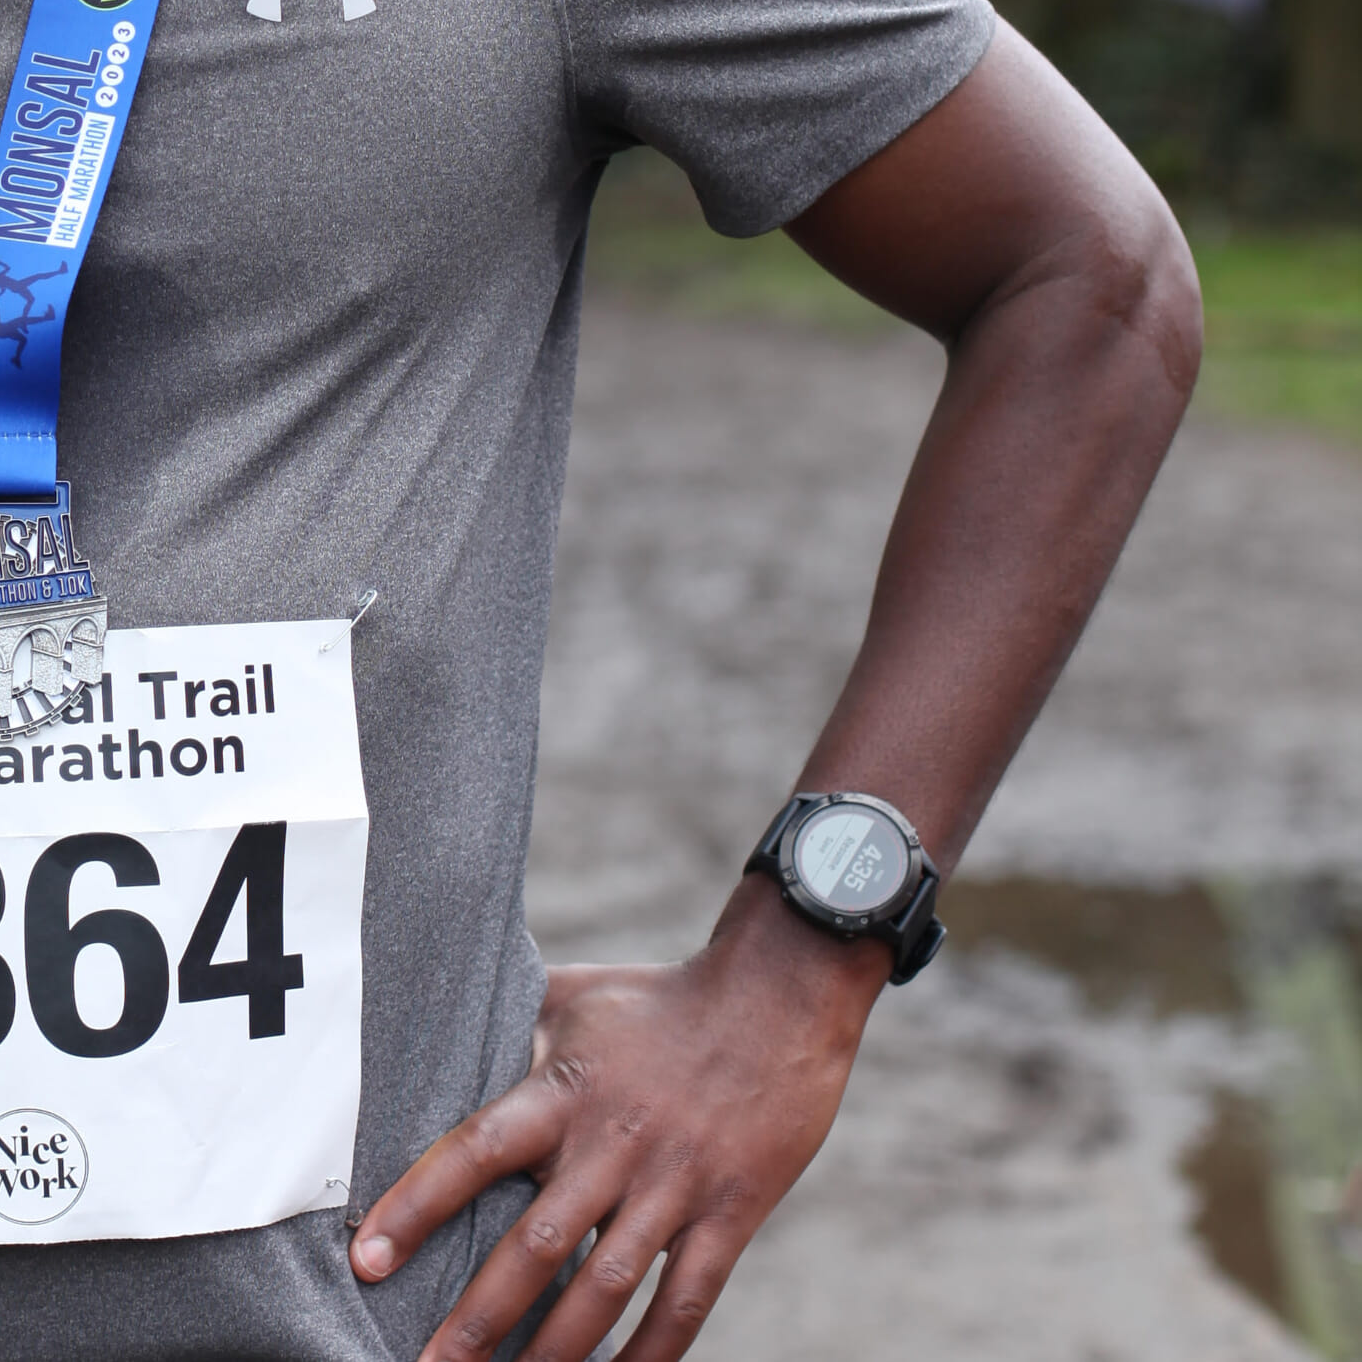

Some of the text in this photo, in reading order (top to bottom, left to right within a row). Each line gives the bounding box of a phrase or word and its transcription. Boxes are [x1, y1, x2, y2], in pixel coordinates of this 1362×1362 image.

[97, 23, 134, 106] 2023
[54, 119, 110, 242] HALF MARATHON
[41, 579, 52, 599] &
[58, 575, 89, 597] 10K
[138, 663, 276, 721] Trail
[843, 843, 883, 893] 4:35
